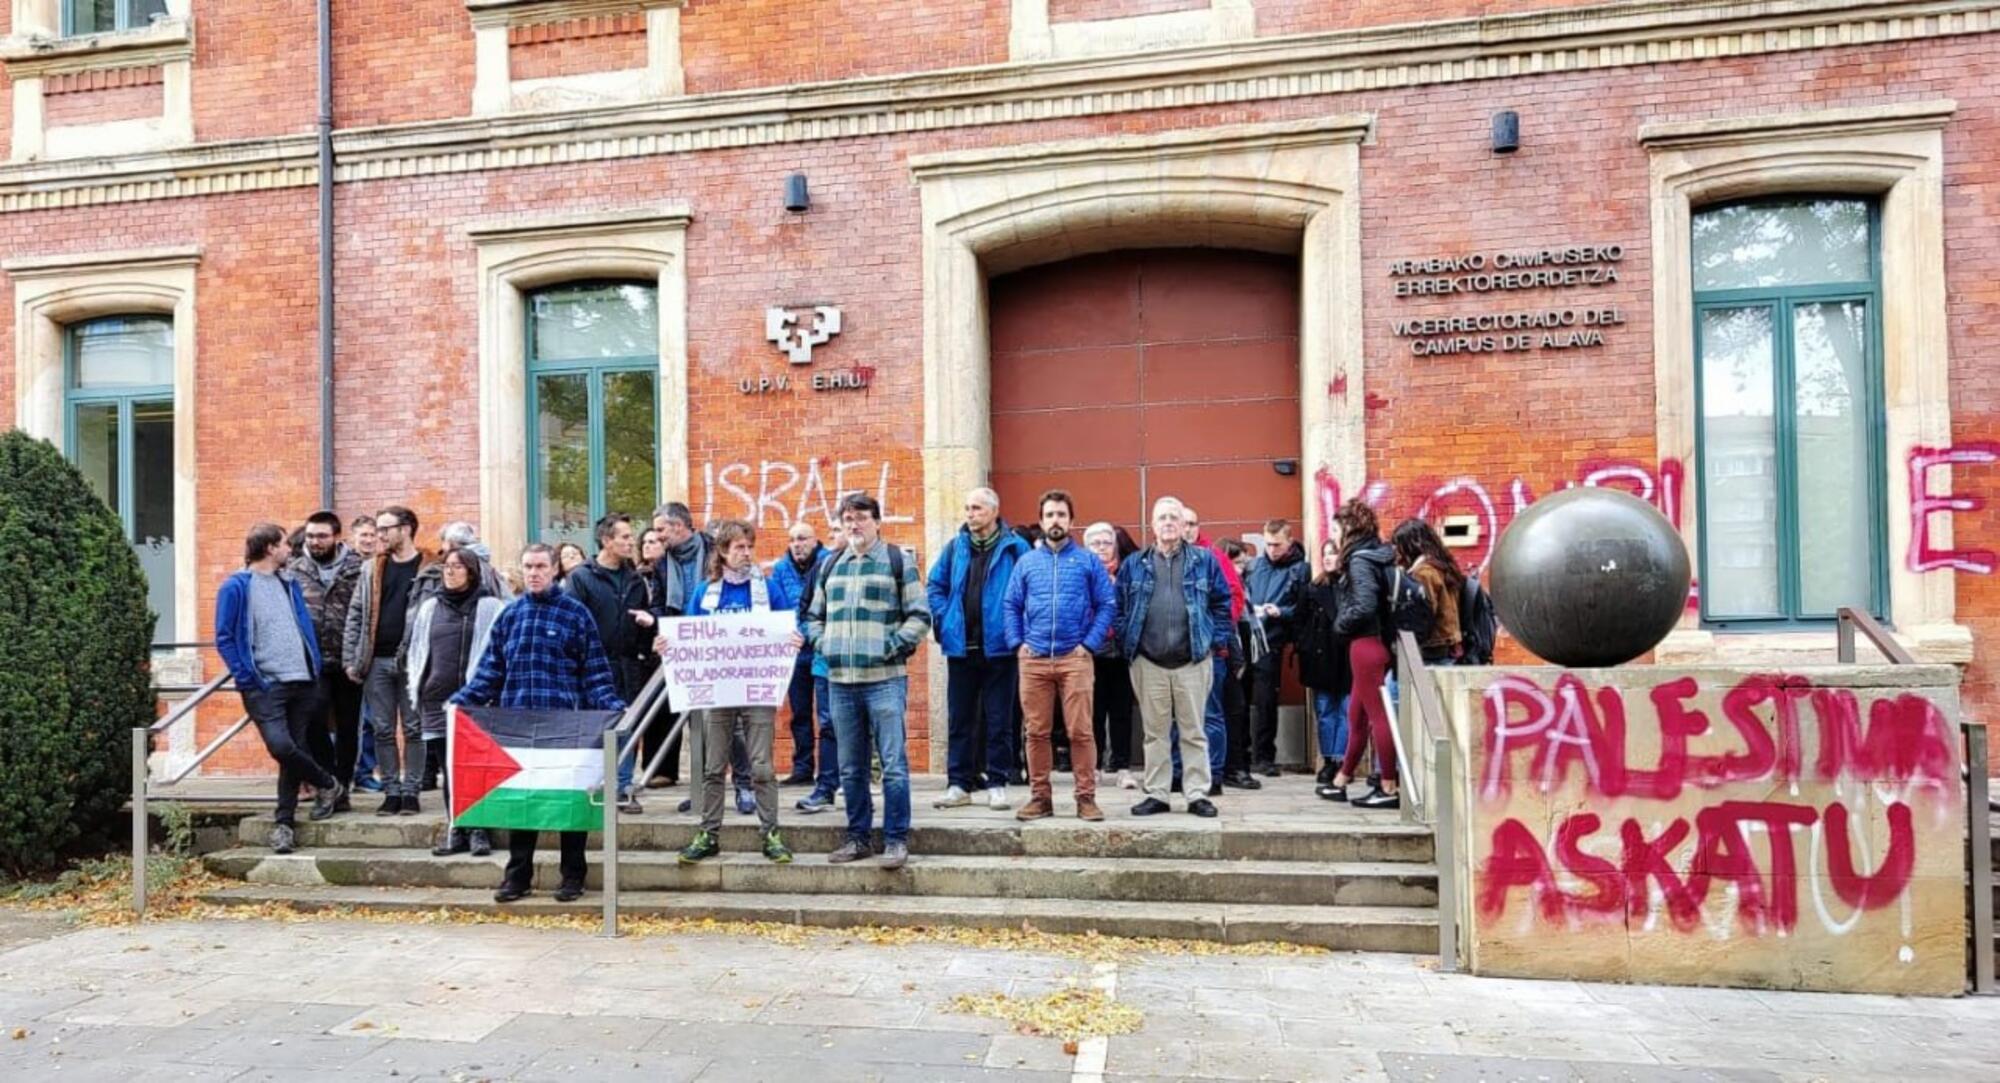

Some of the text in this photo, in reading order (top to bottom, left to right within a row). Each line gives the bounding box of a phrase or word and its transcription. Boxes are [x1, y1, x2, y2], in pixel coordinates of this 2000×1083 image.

[1389, 245, 1623, 277] ARABAKO CAMPUSEKO
[1394, 266, 1618, 298] ERREKTOREORDETZA
[1391, 306, 1625, 337] VICERRECTORADO DEL
[1410, 329, 1605, 357] CAMPUS DE ALAVA
[746, 683, 777, 703] EZ
